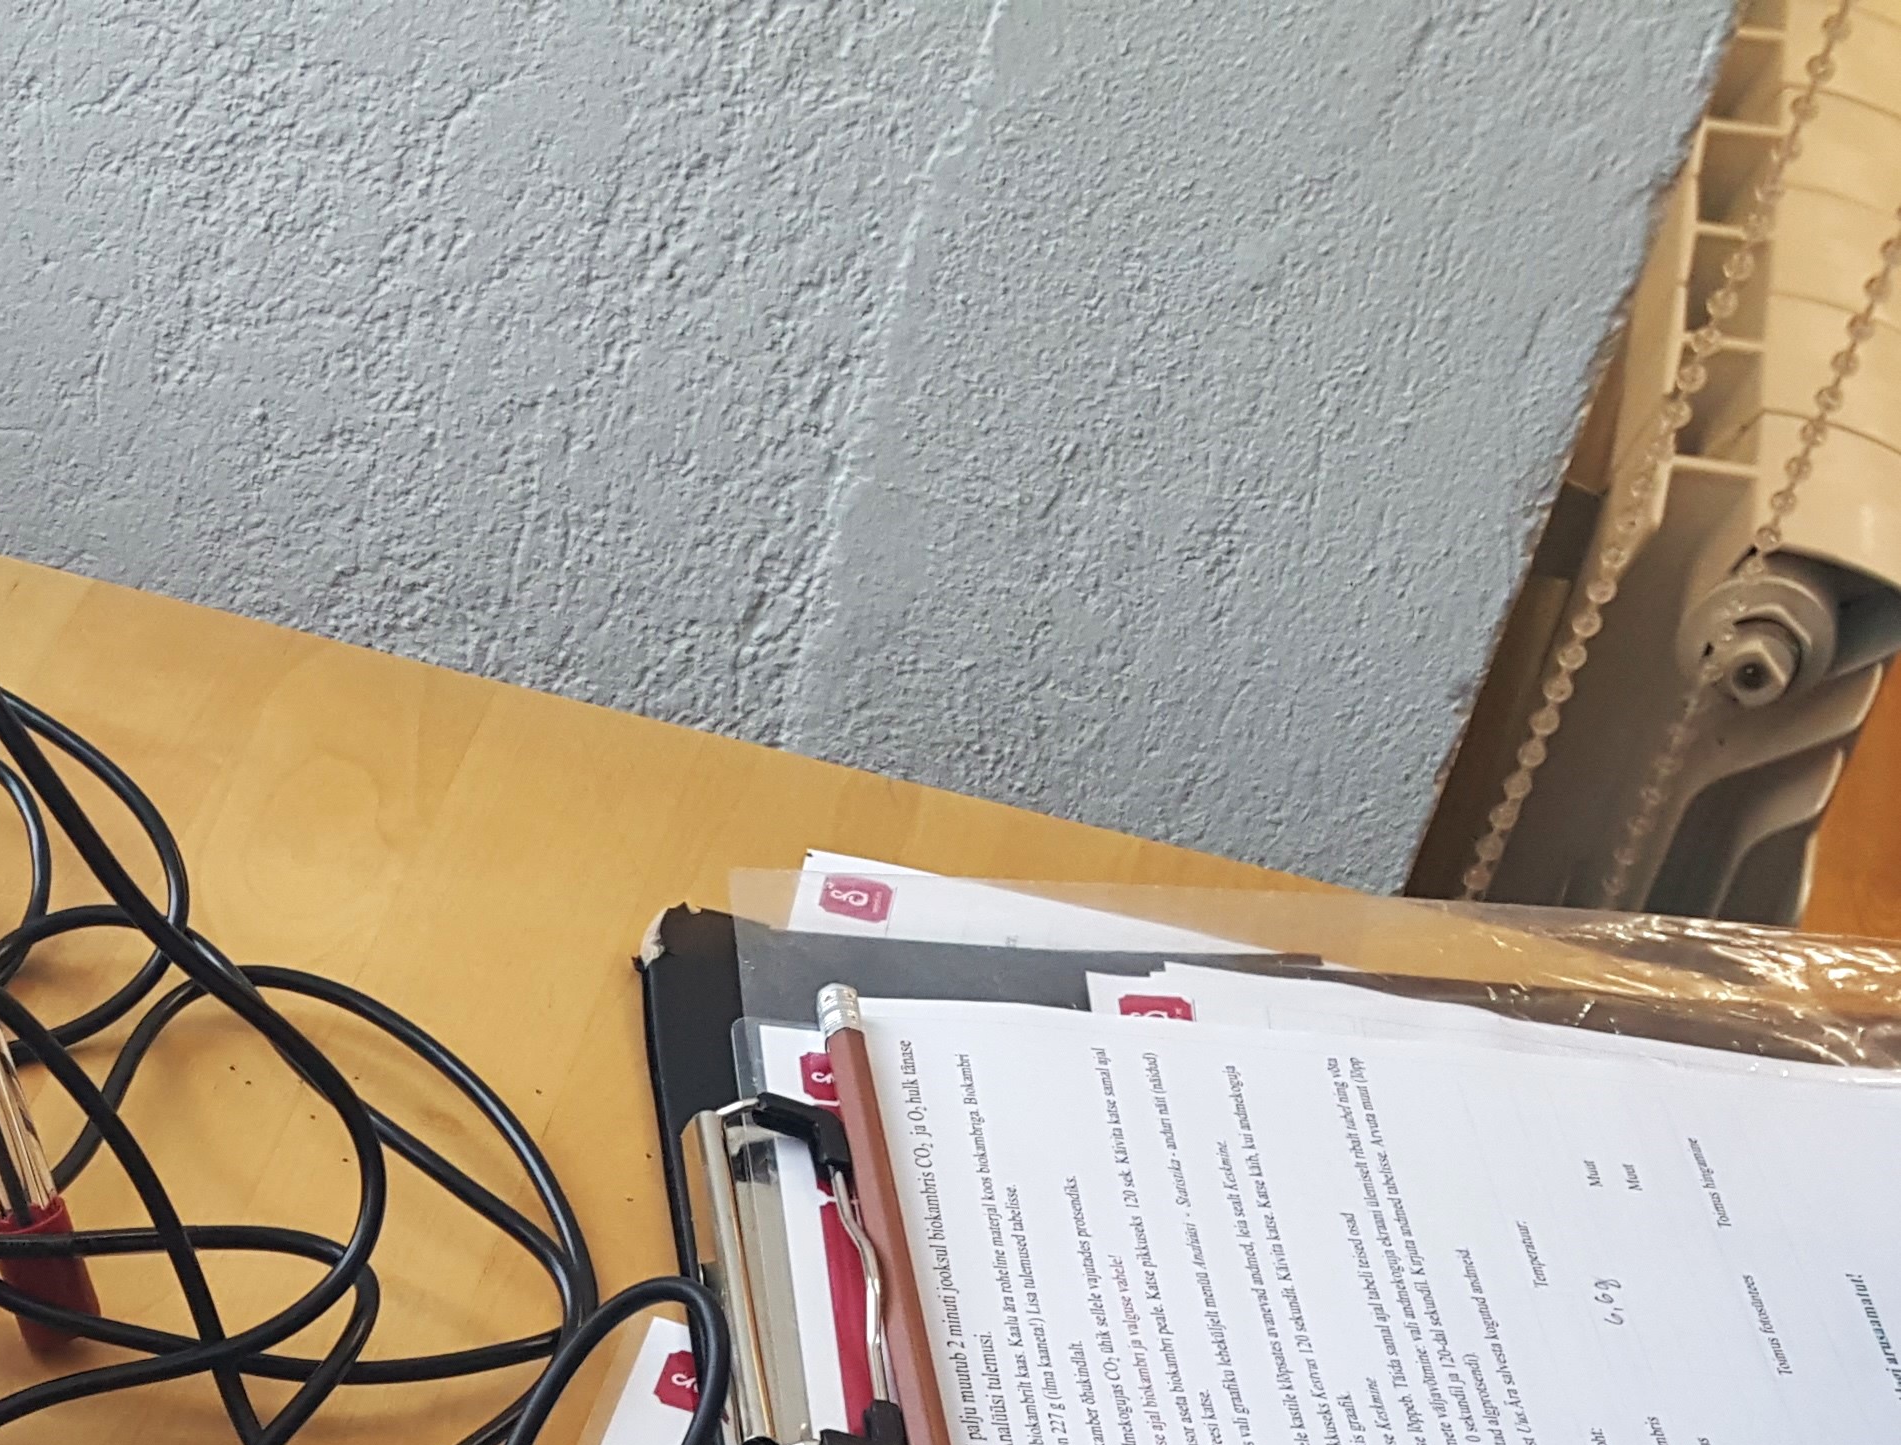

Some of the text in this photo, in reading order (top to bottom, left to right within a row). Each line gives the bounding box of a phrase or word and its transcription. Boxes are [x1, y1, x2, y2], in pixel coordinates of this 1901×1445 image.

[898, 1039, 918, 1076] tänase
[900, 1077, 924, 1105] hulk
[912, 1123, 934, 1139] ja
[919, 1170, 947, 1242] biokambris
[928, 1243, 962, 1296] jooksul
[941, 1294, 964, 1338] minuti
[1843, 1272, 1899, 1366] arusaamatut!
[945, 1339, 967, 1350] 2
[978, 1330, 1004, 1391] tulemusi.
[948, 1351, 977, 1404] muutub
[1066, 1339, 1097, 1406] õhukindlalt.
[959, 1406, 989, 1443] palju
[1364, 1376, 1394, 1432] Keskmine
